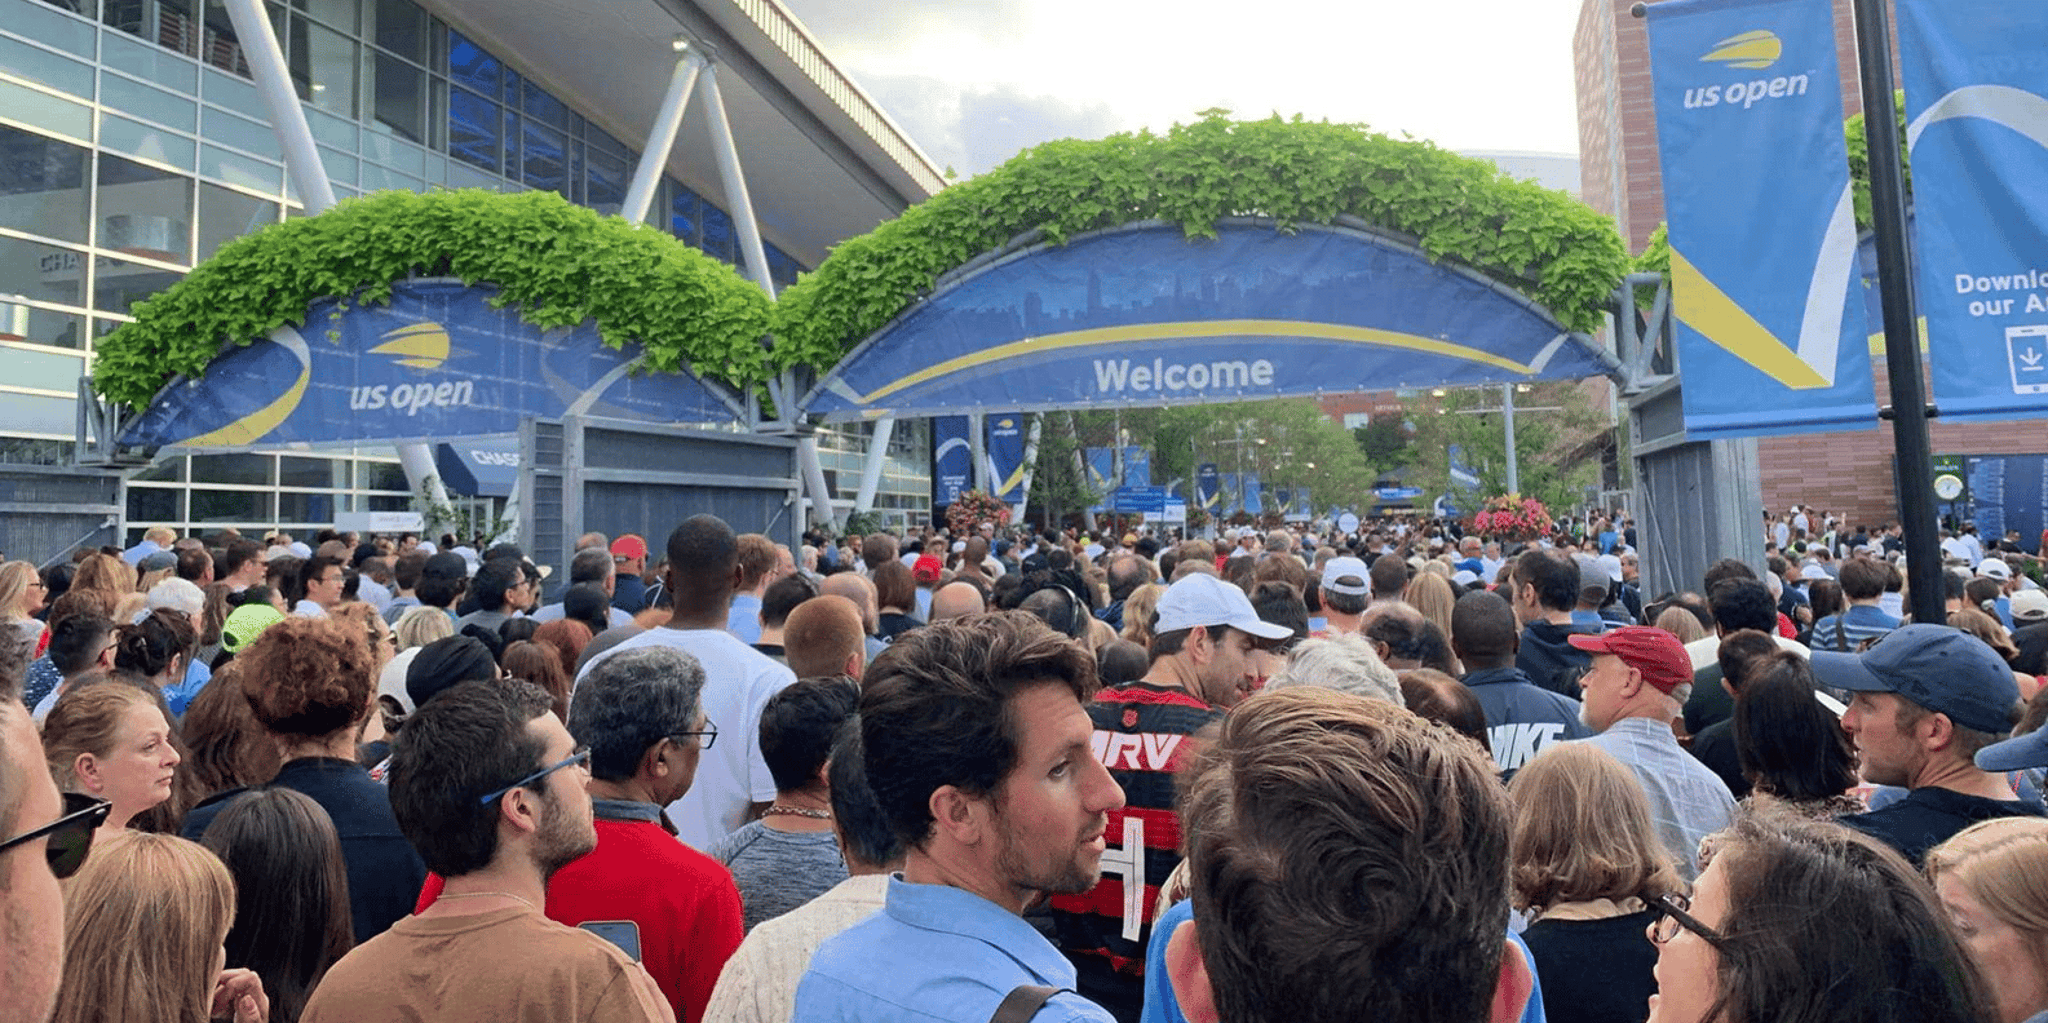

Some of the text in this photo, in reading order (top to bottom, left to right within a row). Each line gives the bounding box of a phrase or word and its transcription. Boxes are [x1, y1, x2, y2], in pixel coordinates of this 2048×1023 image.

[1683, 74, 1808, 109] us open
[1968, 293, 2048, 317] our A
[1093, 356, 1275, 392] Welcome
[350, 379, 474, 417] us open
